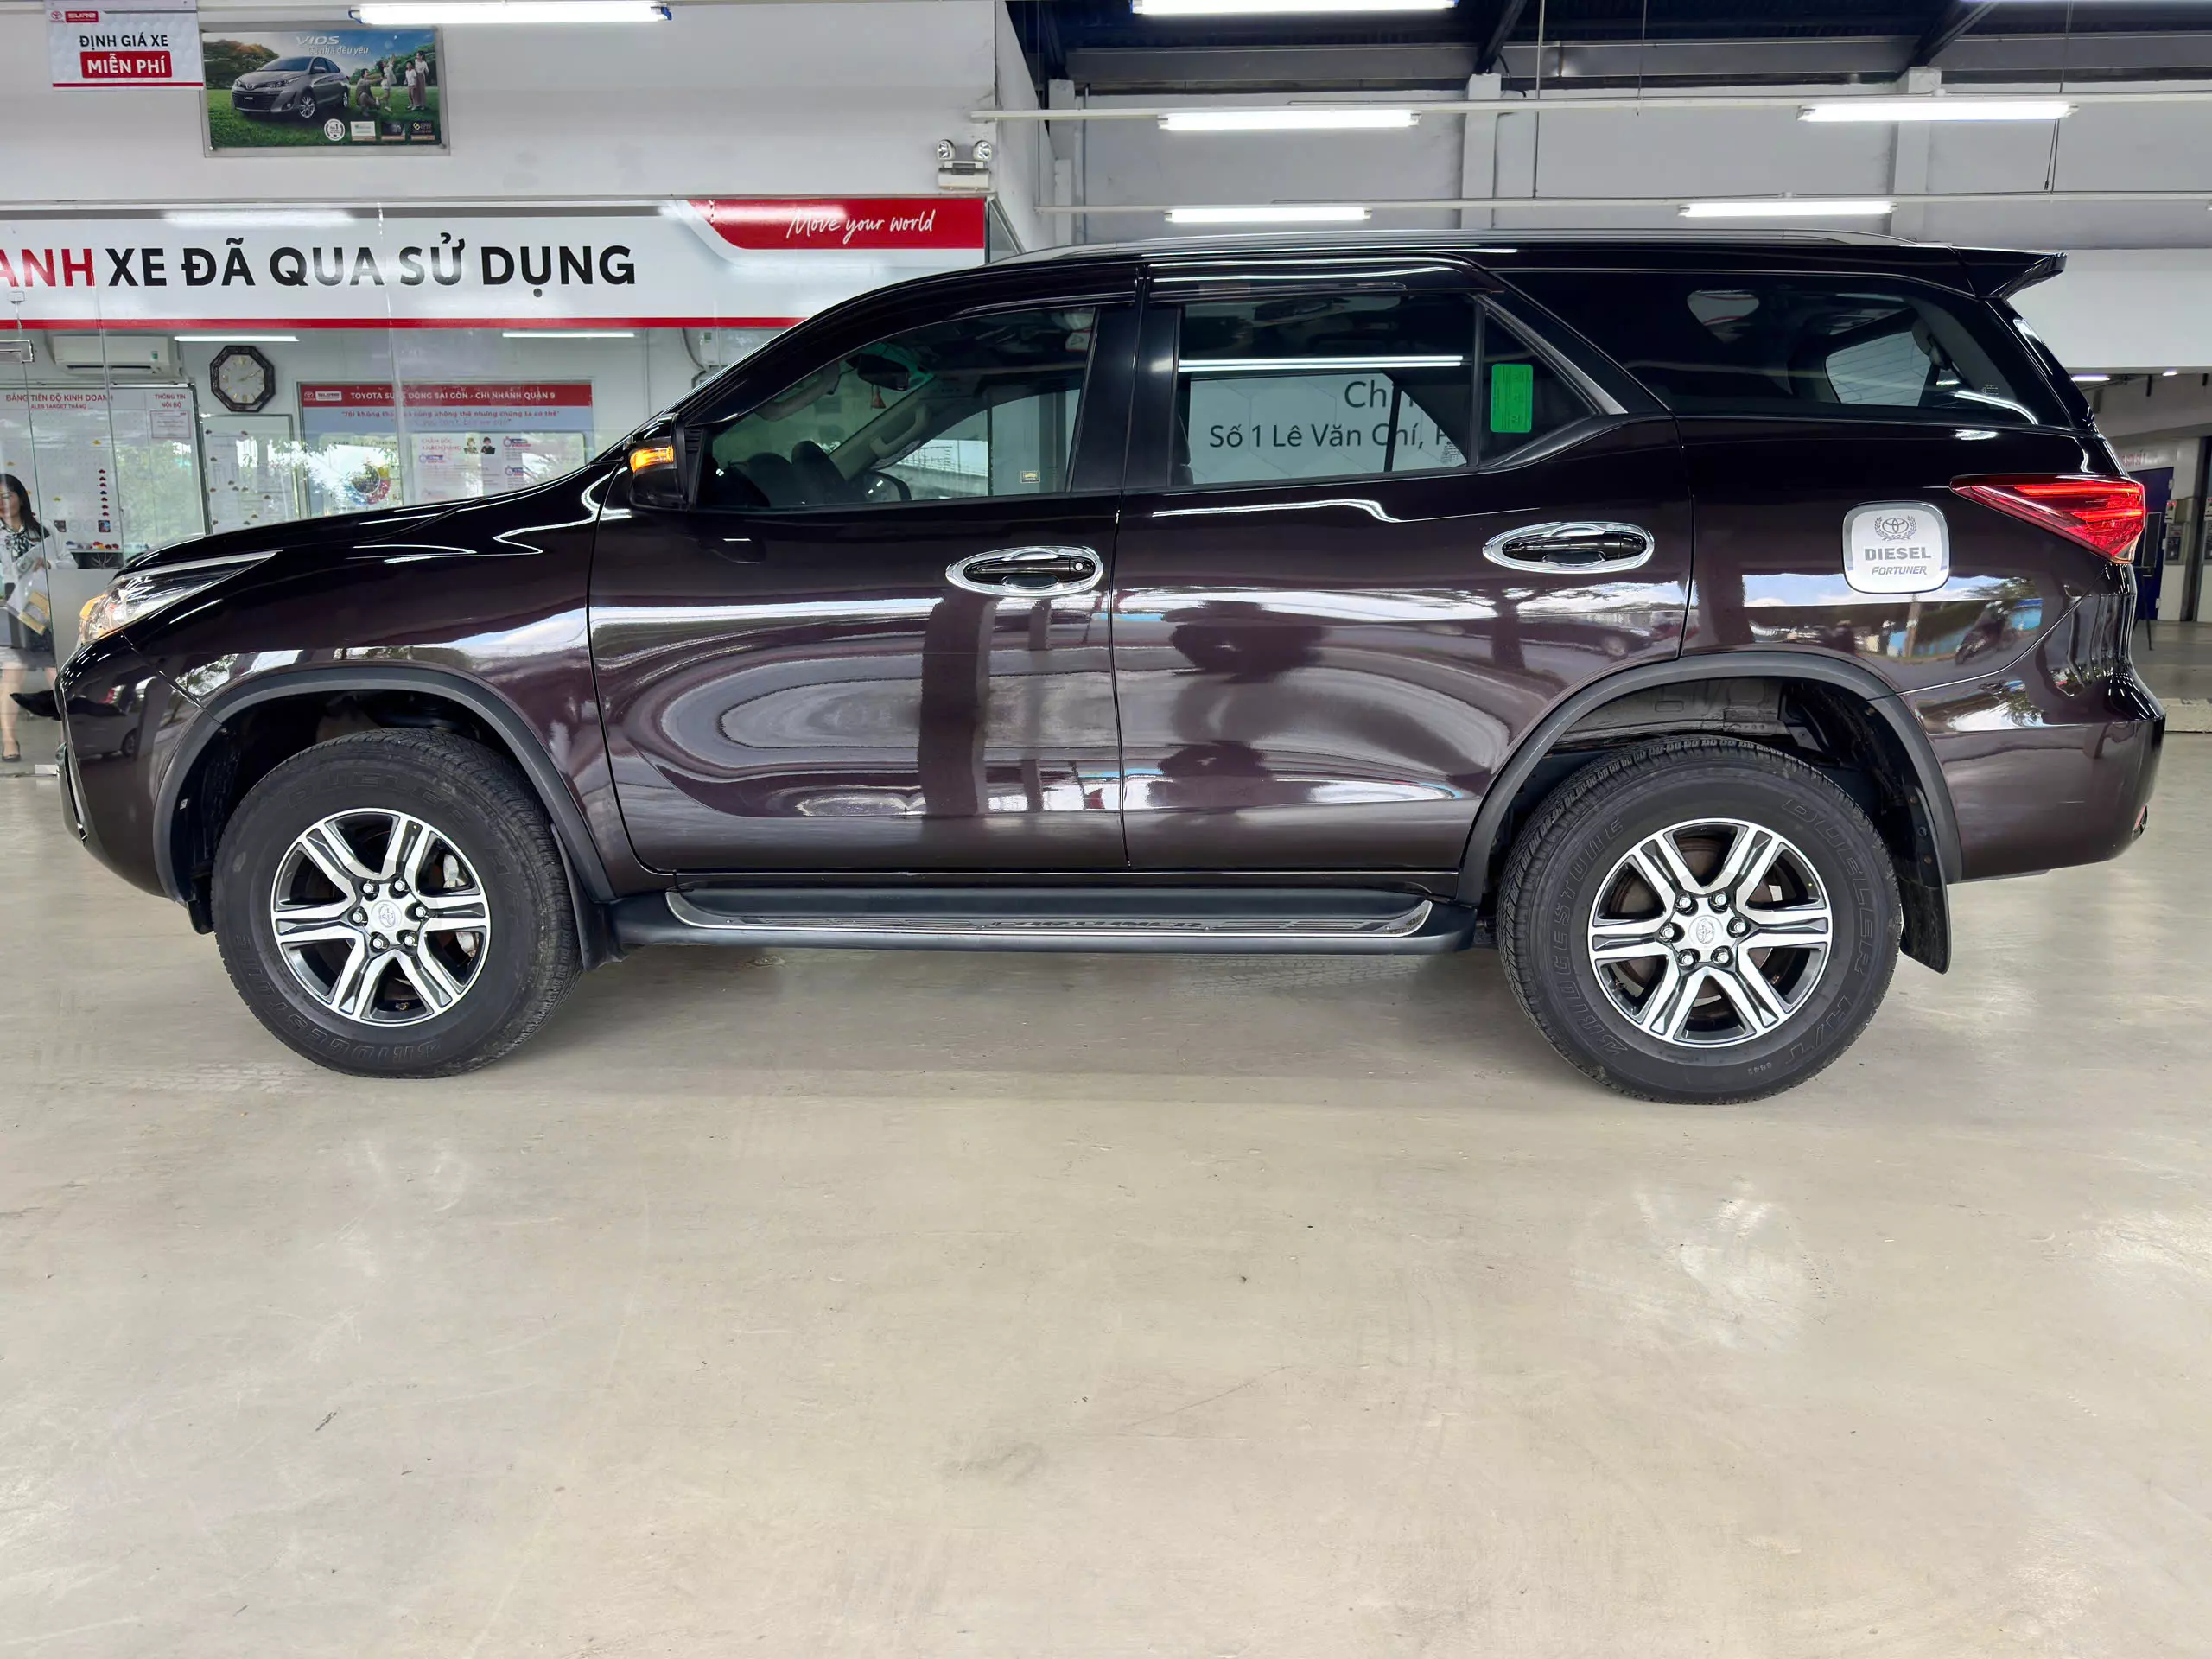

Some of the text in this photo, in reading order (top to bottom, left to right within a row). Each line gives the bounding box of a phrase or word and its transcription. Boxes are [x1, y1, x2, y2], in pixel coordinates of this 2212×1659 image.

[79, 32, 168, 50] ĐỊNH GIÁ XE
[296, 35, 340, 45] VIOS
[87, 53, 166, 74] MIỄN PHÍ
[785, 209, 937, 244] Move your world
[105, 248, 168, 287] XE
[181, 237, 256, 287] ĐÃ
[269, 246, 385, 287] QUA
[398, 232, 466, 287] SỬ
[480, 245, 635, 298] DỤNG
[1344, 380, 1394, 409] Ch
[1209, 423, 1243, 448] Số
[1253, 424, 1262, 448] 1
[1273, 423, 1303, 448] Lê
[1312, 423, 1362, 448] Văn
[1864, 546, 1932, 561] DIESEL
[1872, 565, 1928, 575] FORTUNER
